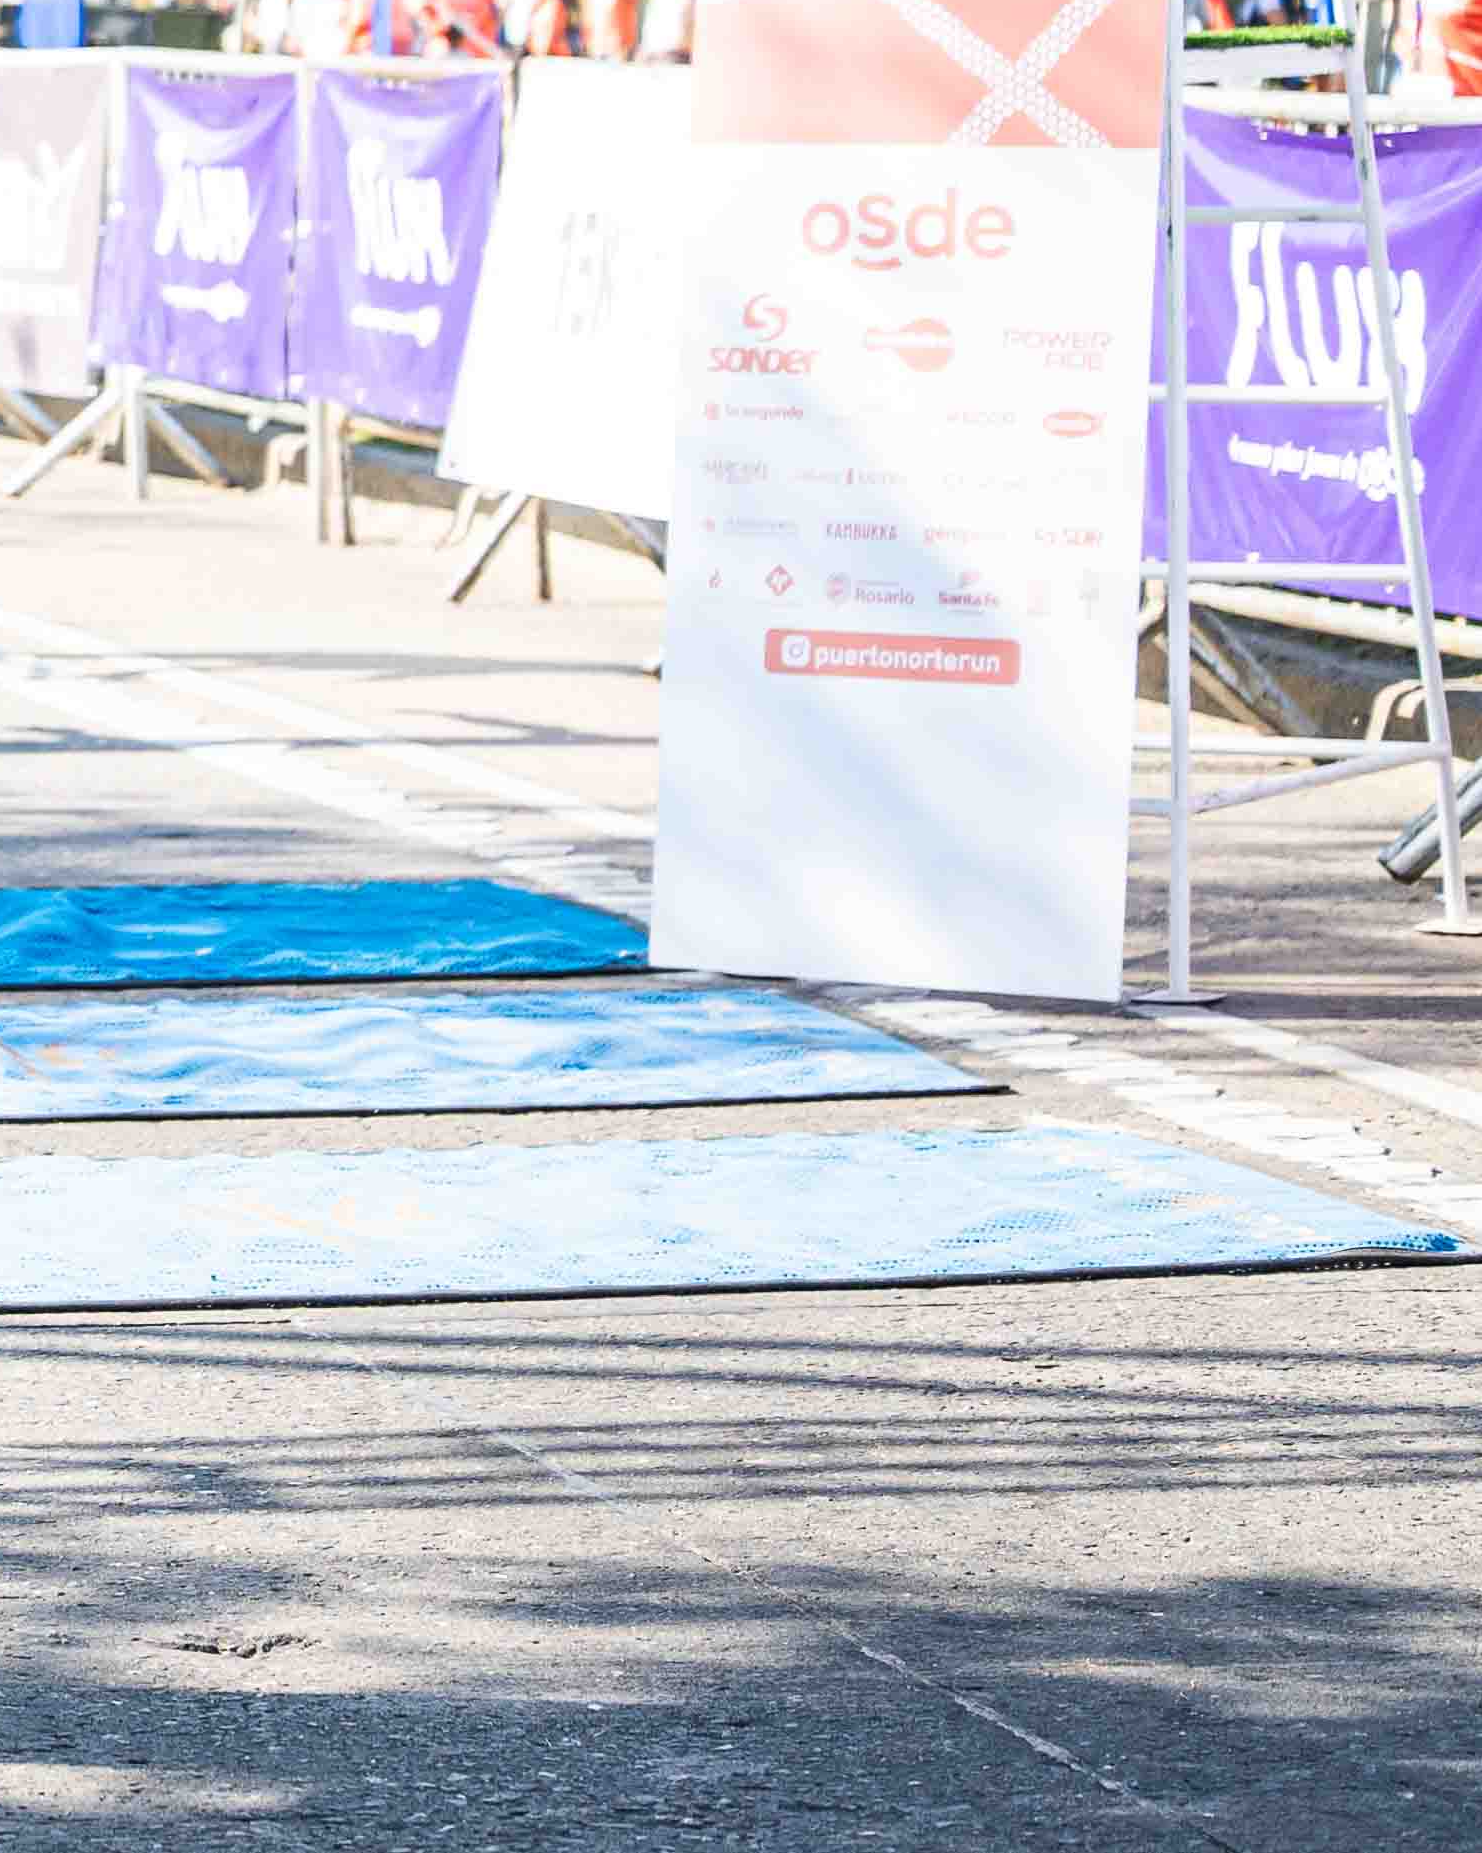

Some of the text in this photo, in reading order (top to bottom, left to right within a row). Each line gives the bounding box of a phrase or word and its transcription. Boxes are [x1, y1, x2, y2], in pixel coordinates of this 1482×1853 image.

[801, 186, 1016, 262] osde
[855, 586, 916, 606] Rosario
[938, 590, 982, 606] Santa
[814, 643, 1001, 675] puertonorterun
